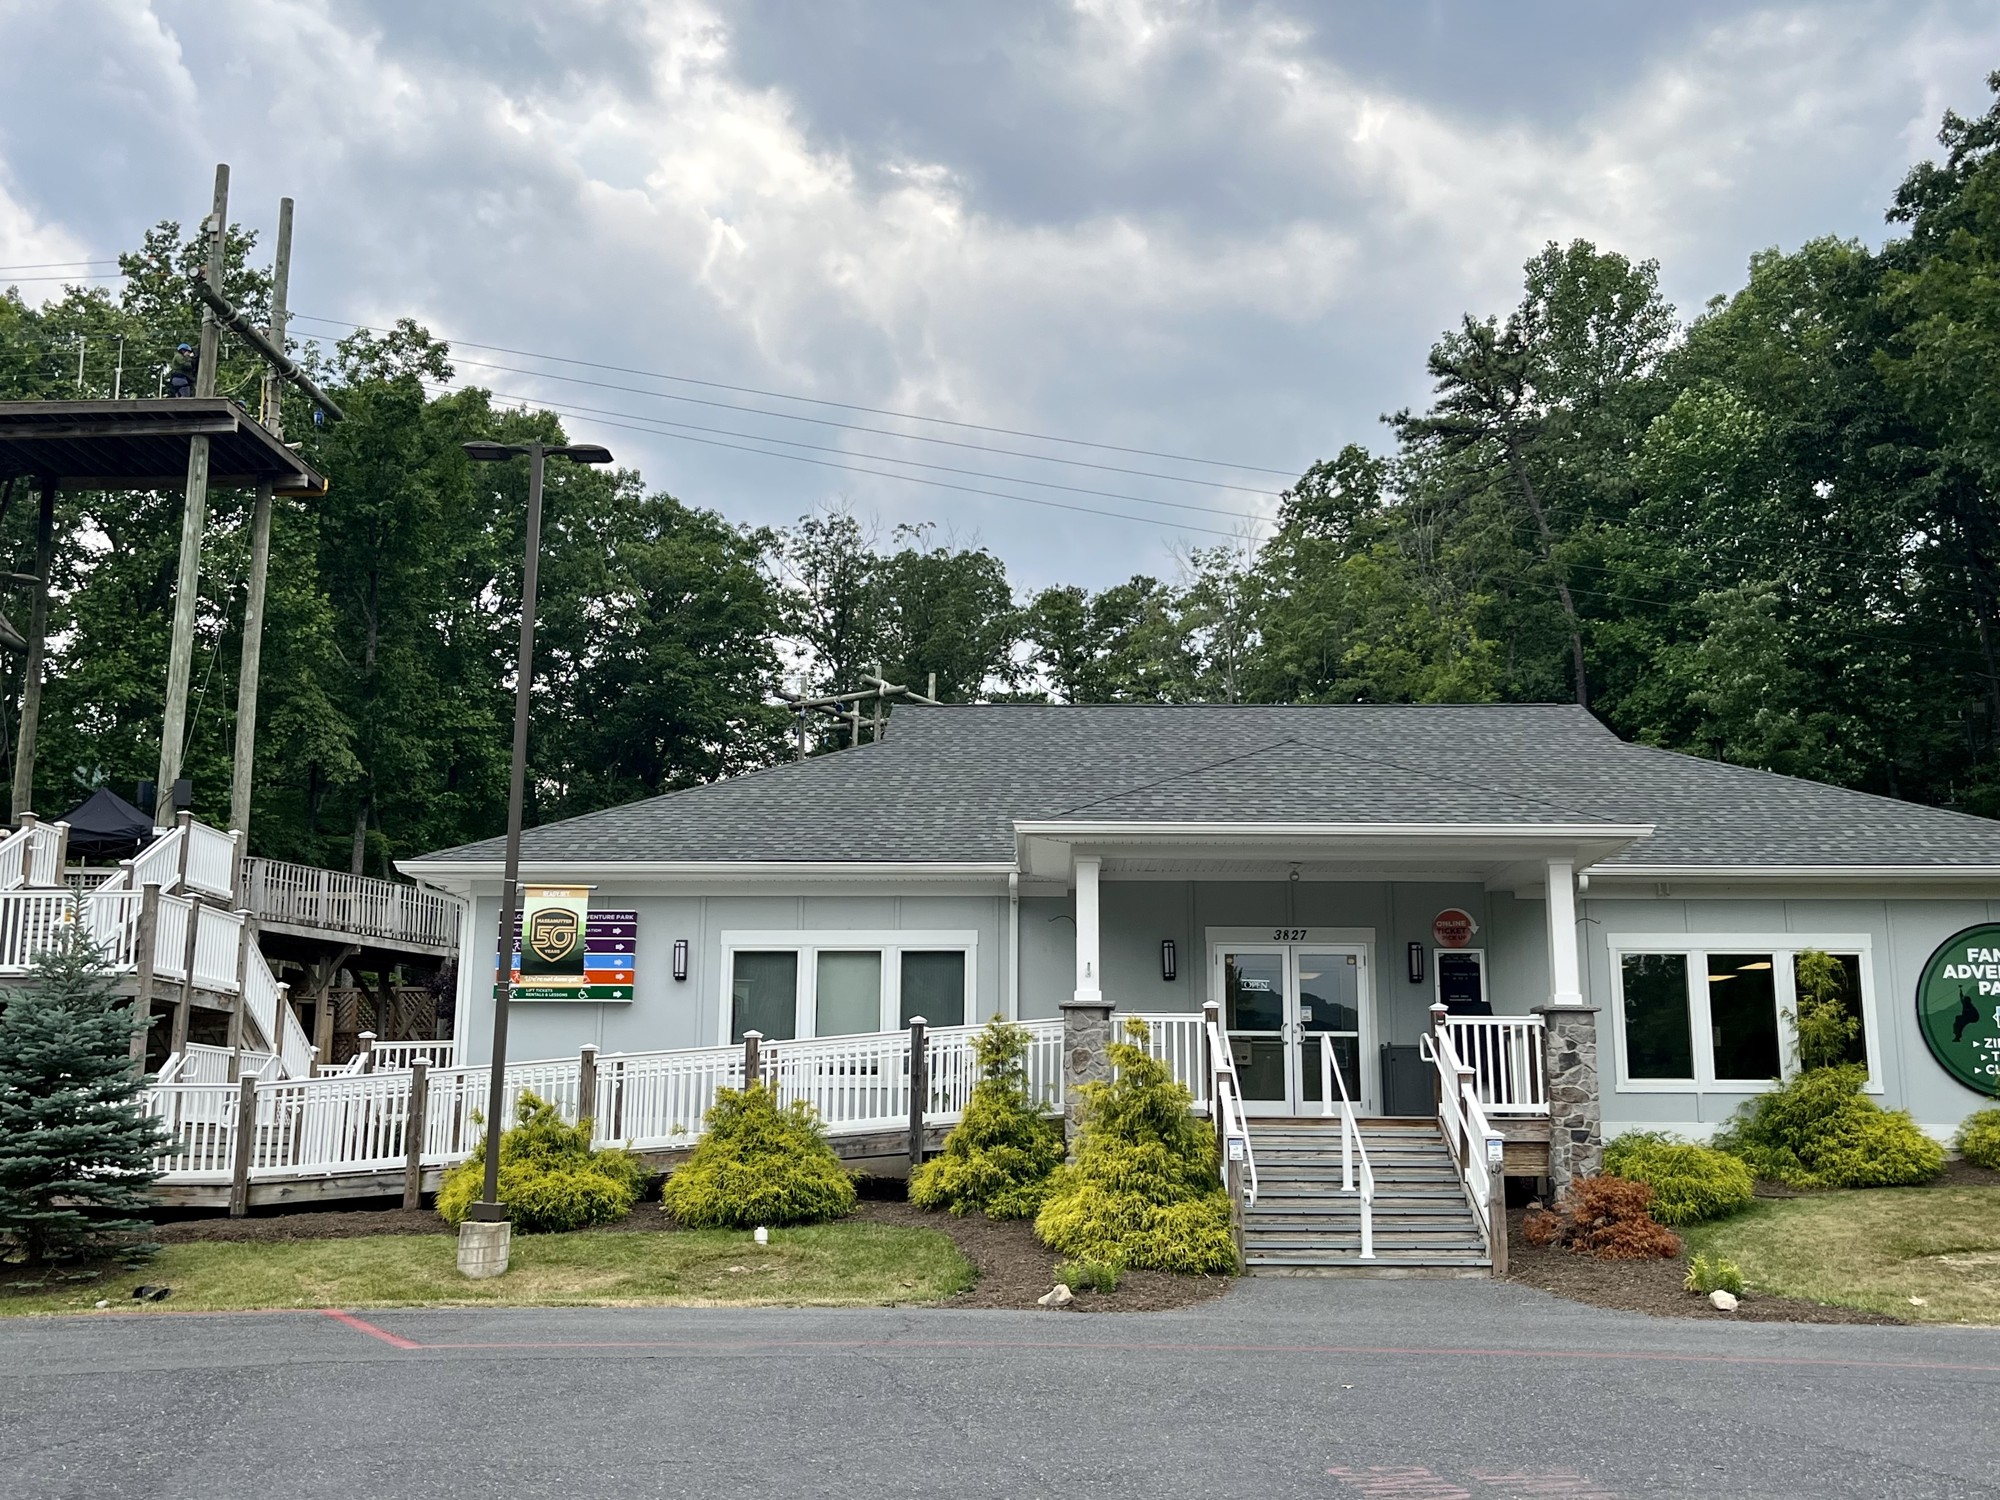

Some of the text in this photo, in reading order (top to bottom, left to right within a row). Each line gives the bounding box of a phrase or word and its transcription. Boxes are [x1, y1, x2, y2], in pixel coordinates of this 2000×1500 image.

[536, 926, 572, 948] 50
[1273, 929, 1307, 941] 3827
[1436, 927, 1467, 935] TICKET
[1943, 964, 2000, 979] ADVE
[1243, 981, 1268, 989] OPEN
